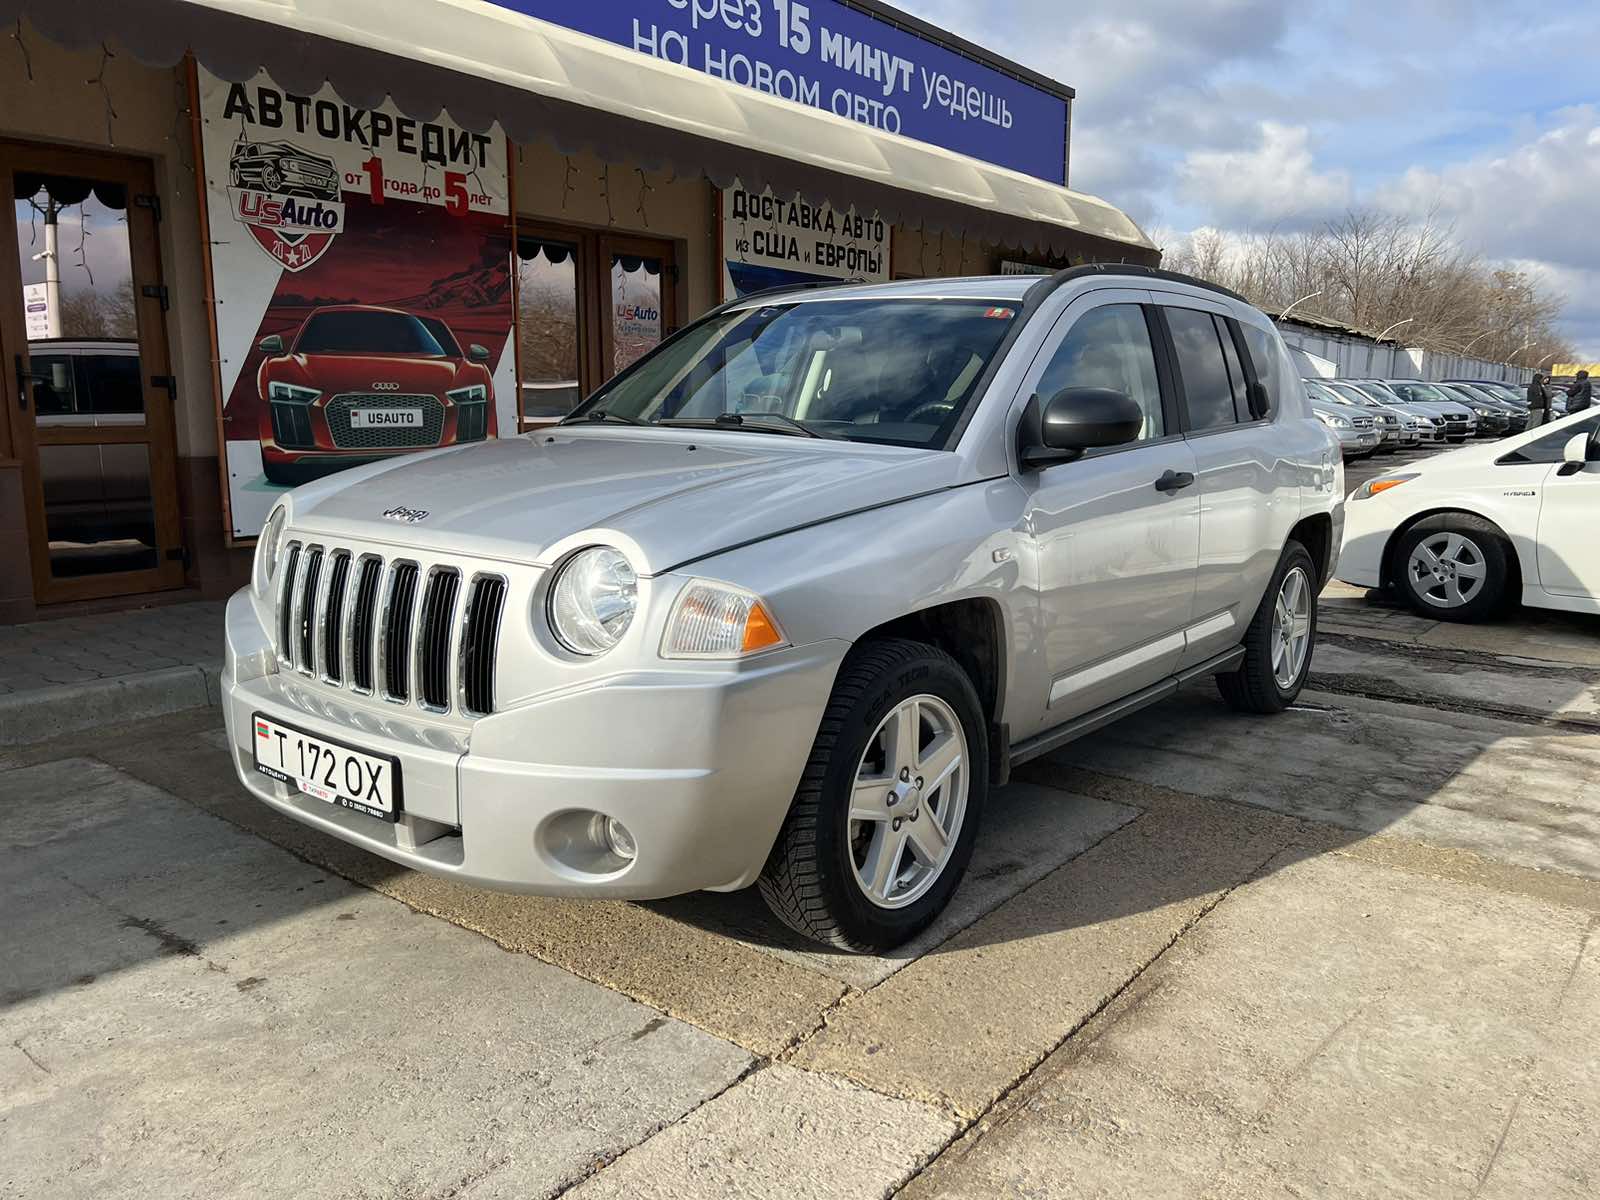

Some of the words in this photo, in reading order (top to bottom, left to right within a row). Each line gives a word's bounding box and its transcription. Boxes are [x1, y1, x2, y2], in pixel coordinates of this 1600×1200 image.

[633, 18, 689, 66] на
[705, 43, 820, 108] новом
[831, 88, 901, 135] авто
[667, 0, 763, 37] рез
[773, 0, 812, 54] 15
[821, 27, 914, 96] минут
[921, 65, 1013, 129] уедешь
[223, 83, 492, 168] АВТОКРЕДИТ
[345, 173, 363, 185] от
[362, 156, 384, 205] 1
[384, 178, 417, 196] года
[423, 185, 441, 199] до
[444, 171, 469, 217] 5
[470, 193, 493, 206] лет
[732, 190, 835, 234] ДОСТАВКА
[842, 213, 884, 242] АВТО
[736, 238, 750, 253] из
[753, 231, 800, 261] США
[804, 251, 811, 264] и
[815, 241, 882, 274] ЕВРОПЫ
[368, 413, 414, 424] USAUTO
[274, 730, 288, 768] T
[298, 739, 337, 790] 172
[345, 756, 384, 806] OX
